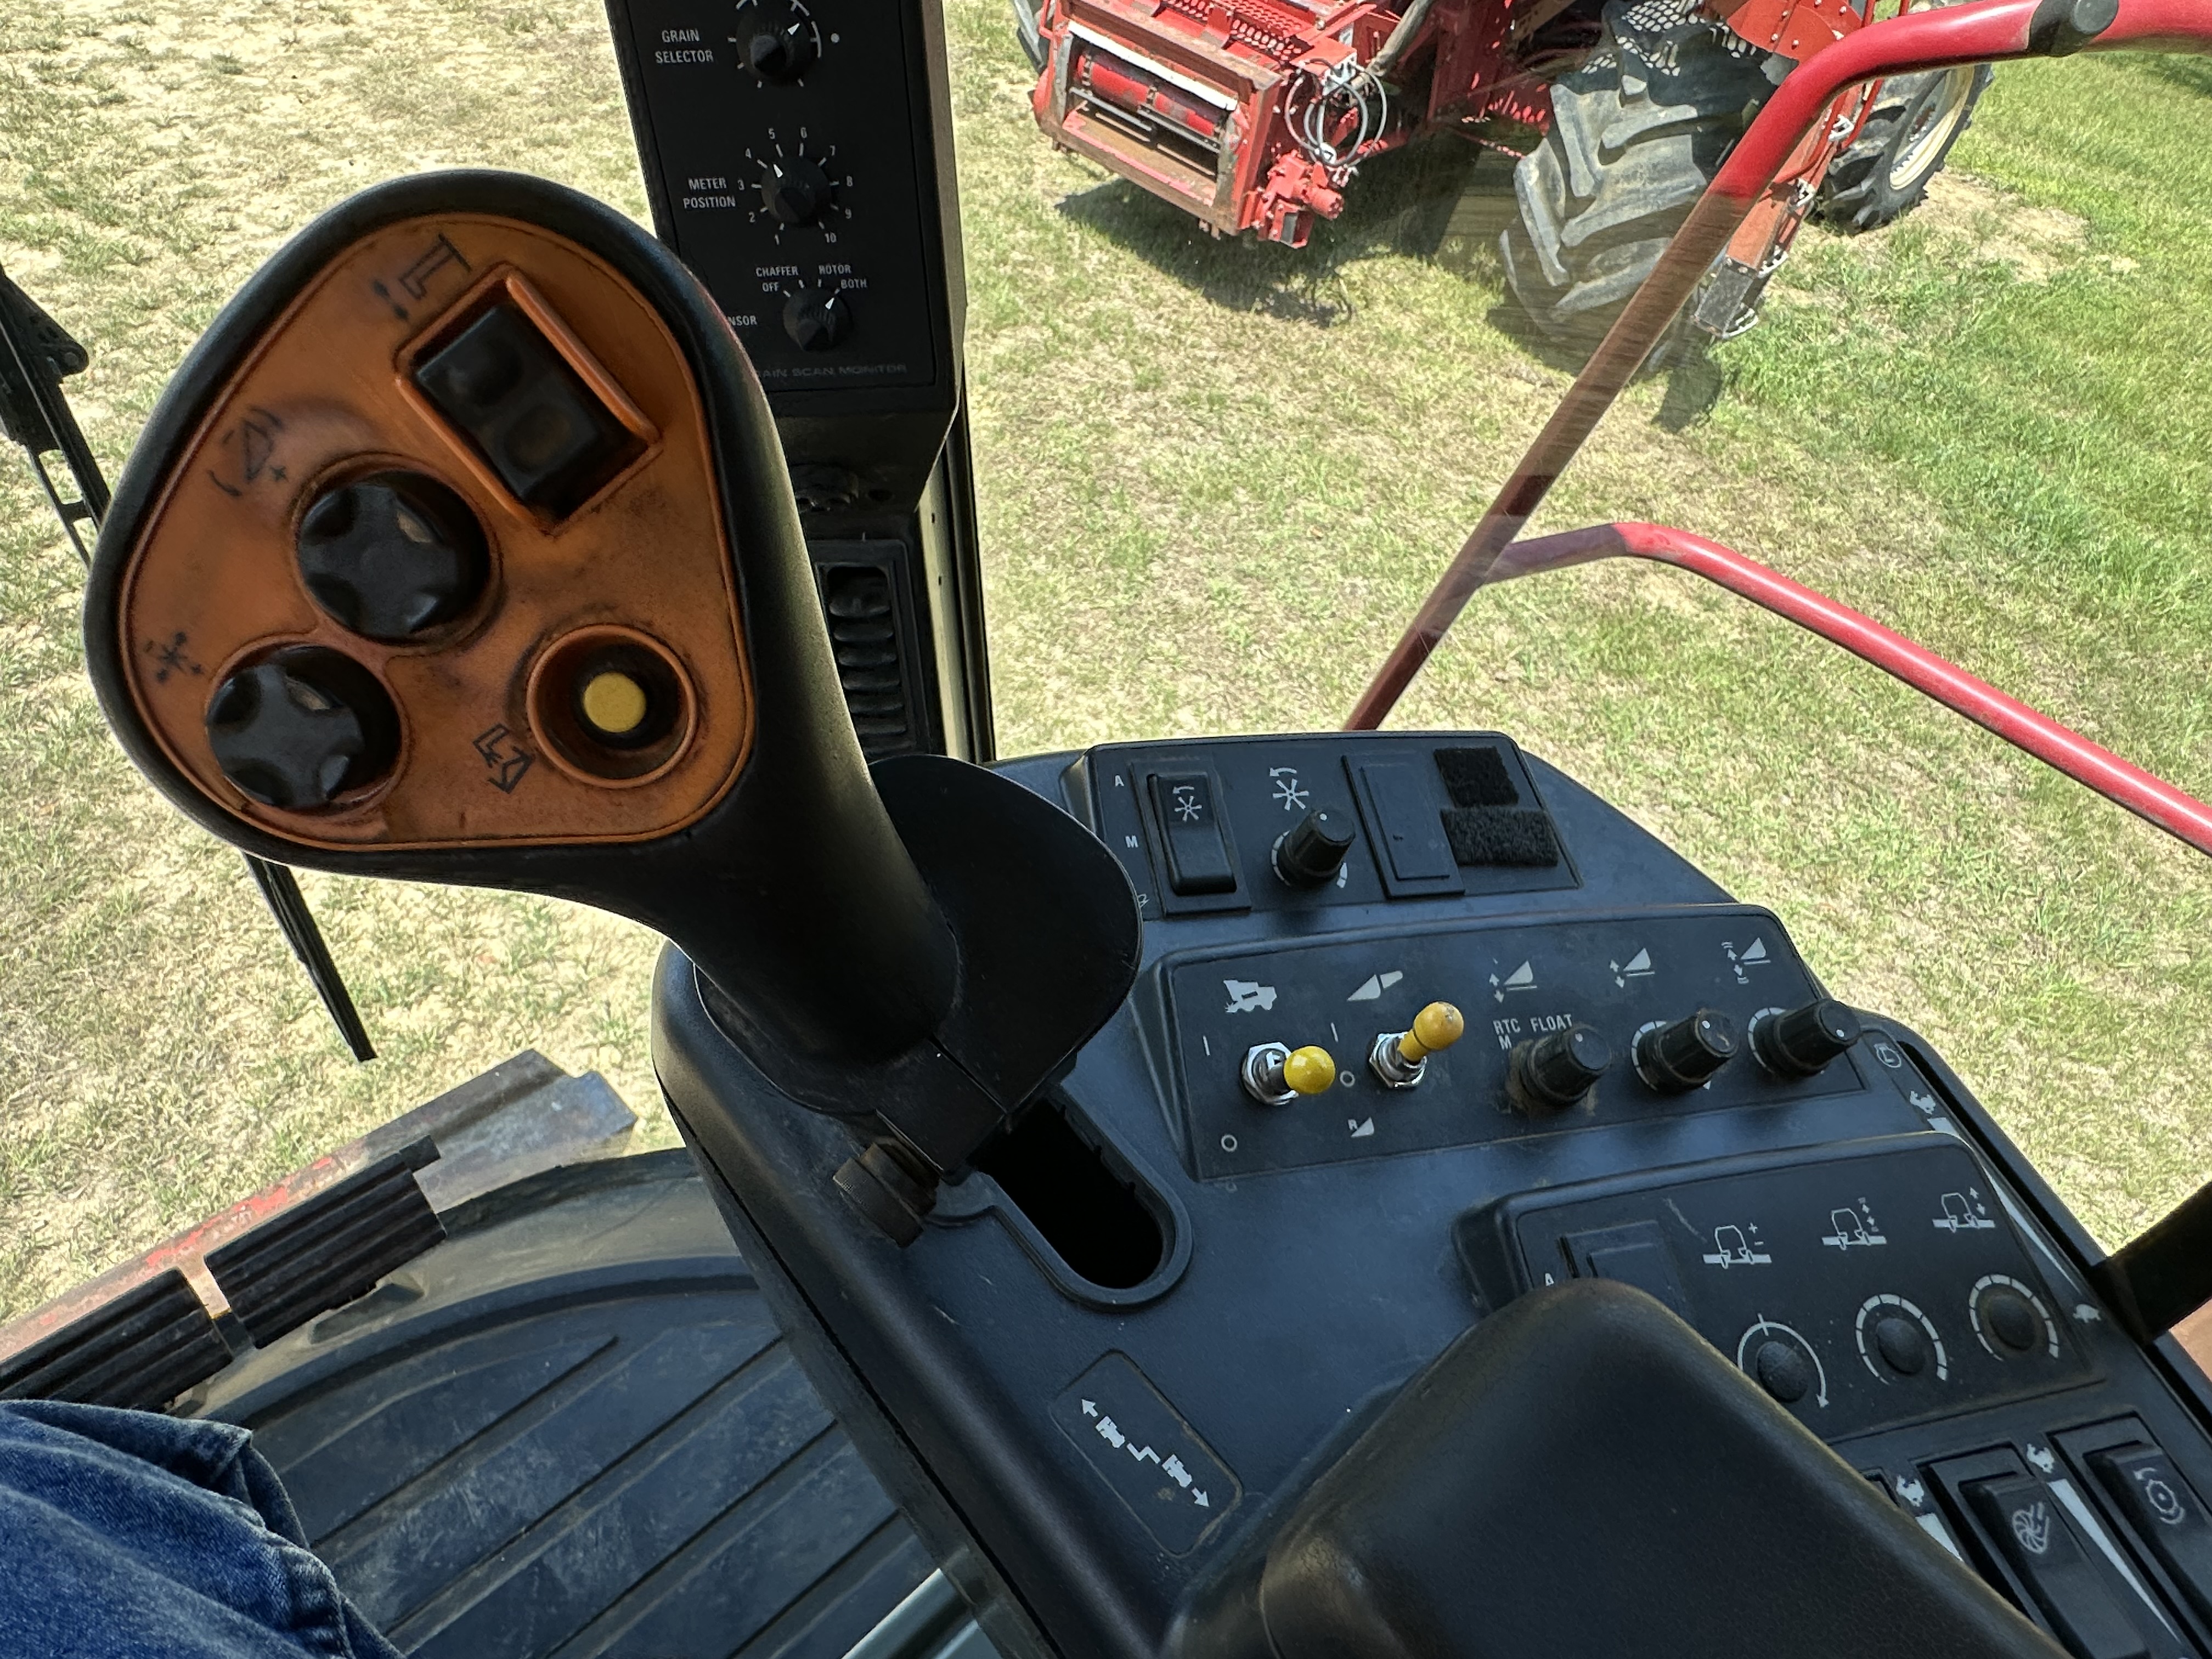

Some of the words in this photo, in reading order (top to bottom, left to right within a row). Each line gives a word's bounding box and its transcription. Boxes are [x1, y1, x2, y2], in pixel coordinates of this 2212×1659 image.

[662, 29, 700, 43] GRAIN
[655, 49, 713, 64] SELECTOR
[768, 128, 775, 139] 5
[800, 127, 808, 139] 6
[745, 148, 752, 159] 4
[830, 145, 836, 156] 7
[688, 178, 726, 190] METER
[737, 179, 744, 190] 3
[846, 176, 853, 187] 8
[683, 196, 736, 208] POSITION
[748, 212, 755, 223] 2
[845, 208, 851, 219] 9
[775, 234, 780, 245] 1
[825, 232, 837, 244] 10
[755, 266, 799, 276] CHAFFER
[819, 264, 851, 275] ROTOR
[762, 281, 780, 292] OFF
[840, 278, 867, 290] BOTH
[727, 315, 758, 326] NSOR
[763, 368, 787, 378] AIN
[792, 366, 834, 377] SCAN
[839, 362, 909, 375] MONITOR
[1115, 775, 1125, 787] A
[1125, 835, 1138, 848] M
[1492, 1018, 1521, 1035] RTC
[1530, 1014, 1573, 1032] FLOAT
[1498, 1034, 1512, 1050] M
[1347, 1119, 1358, 1131] R
